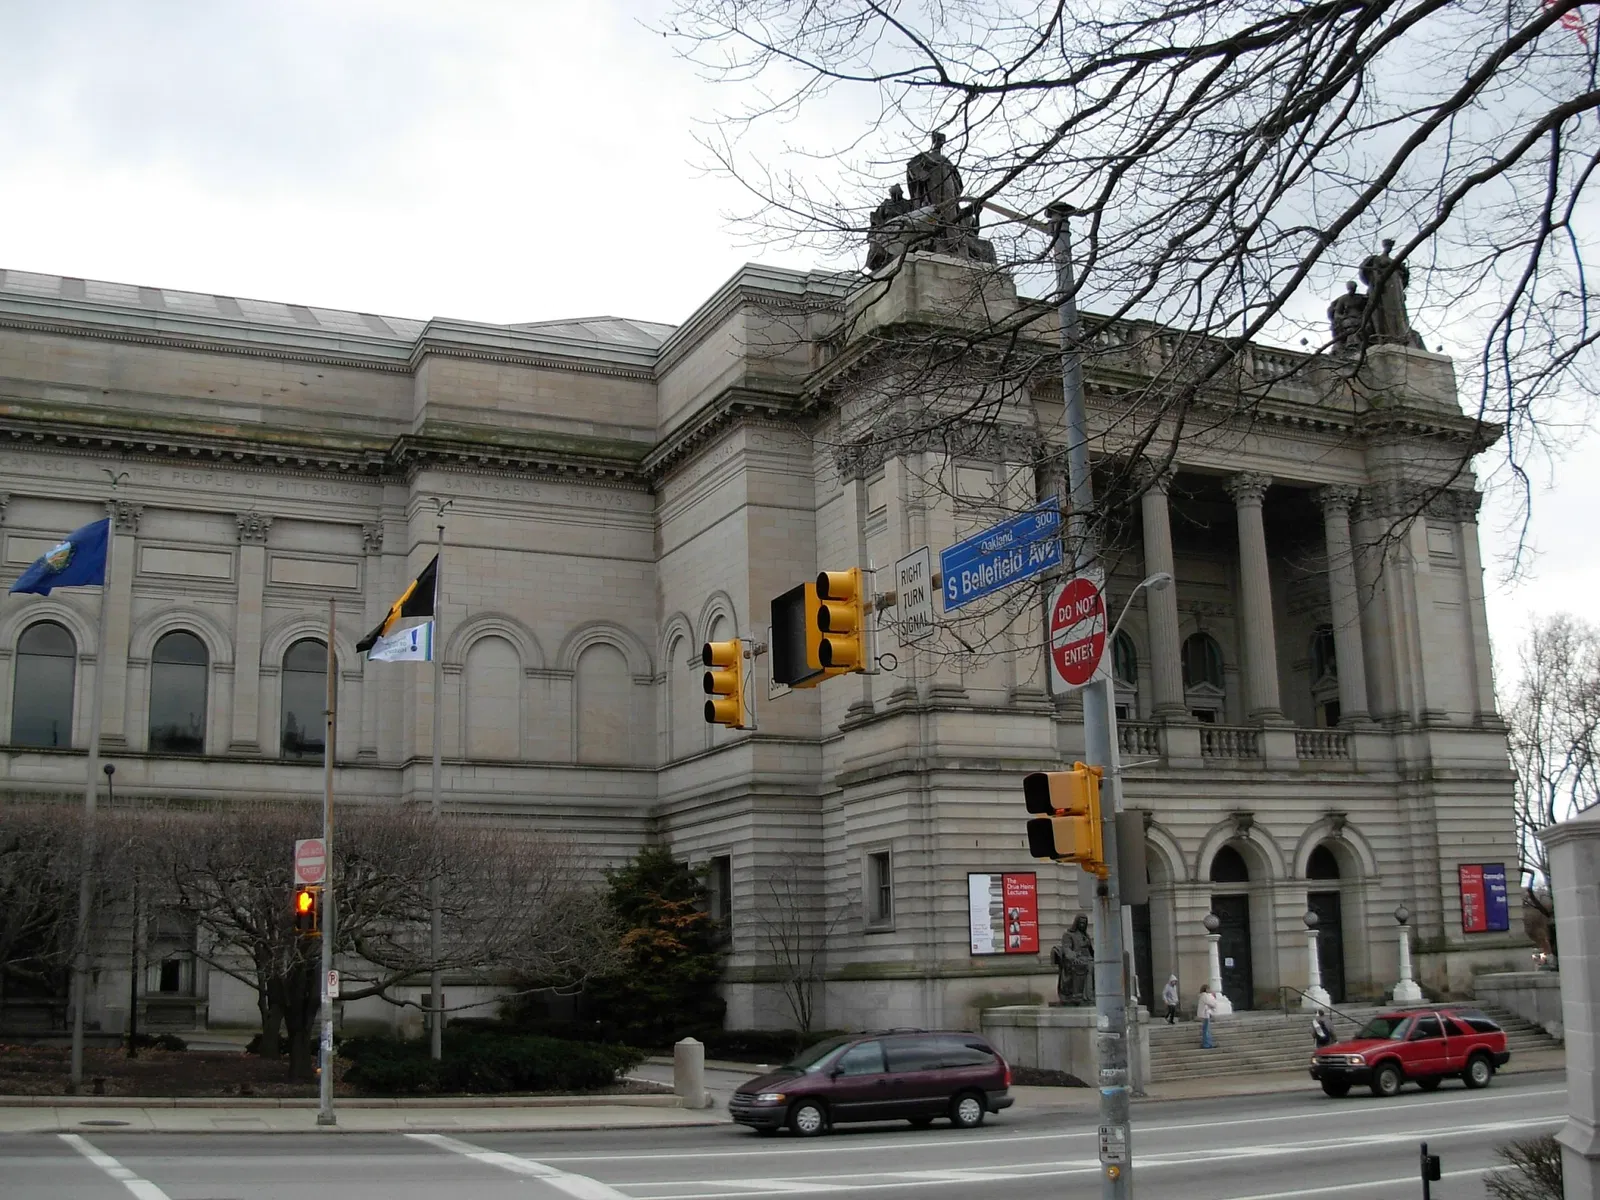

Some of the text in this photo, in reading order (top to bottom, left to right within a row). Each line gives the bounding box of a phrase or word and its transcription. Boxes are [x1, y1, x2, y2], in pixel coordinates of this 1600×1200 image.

[172, 470, 234, 489] PEOPLE
[243, 477, 264, 490] OF
[1035, 511, 1054, 529] 300
[980, 529, 1013, 554] Oakland
[900, 562, 922, 586] RIGHT
[947, 540, 1055, 600] S Bellefield Ave
[903, 586, 924, 609] TURN
[1058, 595, 1096, 623] DO NOT
[900, 611, 928, 637] SIGNAL
[1064, 644, 1095, 666] ENTER
